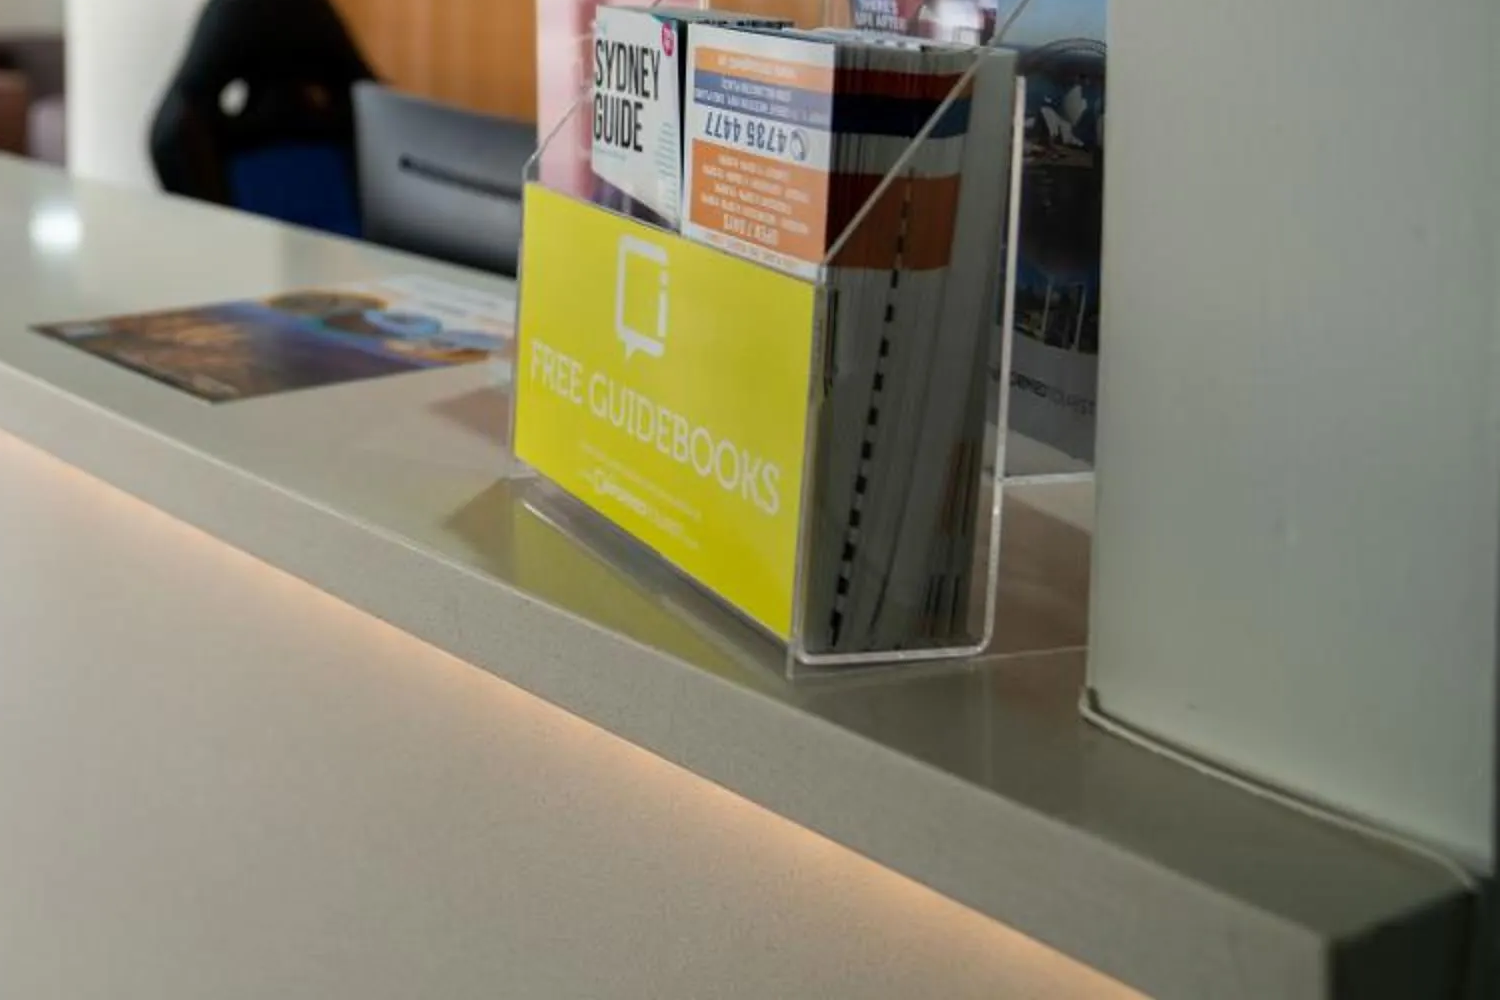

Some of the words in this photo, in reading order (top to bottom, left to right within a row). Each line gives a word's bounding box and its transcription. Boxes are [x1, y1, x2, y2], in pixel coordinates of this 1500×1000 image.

[594, 39, 661, 101] SYDNEY
[593, 92, 644, 152] GUIDE
[704, 111, 741, 140] 4477
[745, 121, 787, 157] 4735
[530, 337, 584, 405] FREE
[588, 370, 780, 516] GUIDEBOOKS
